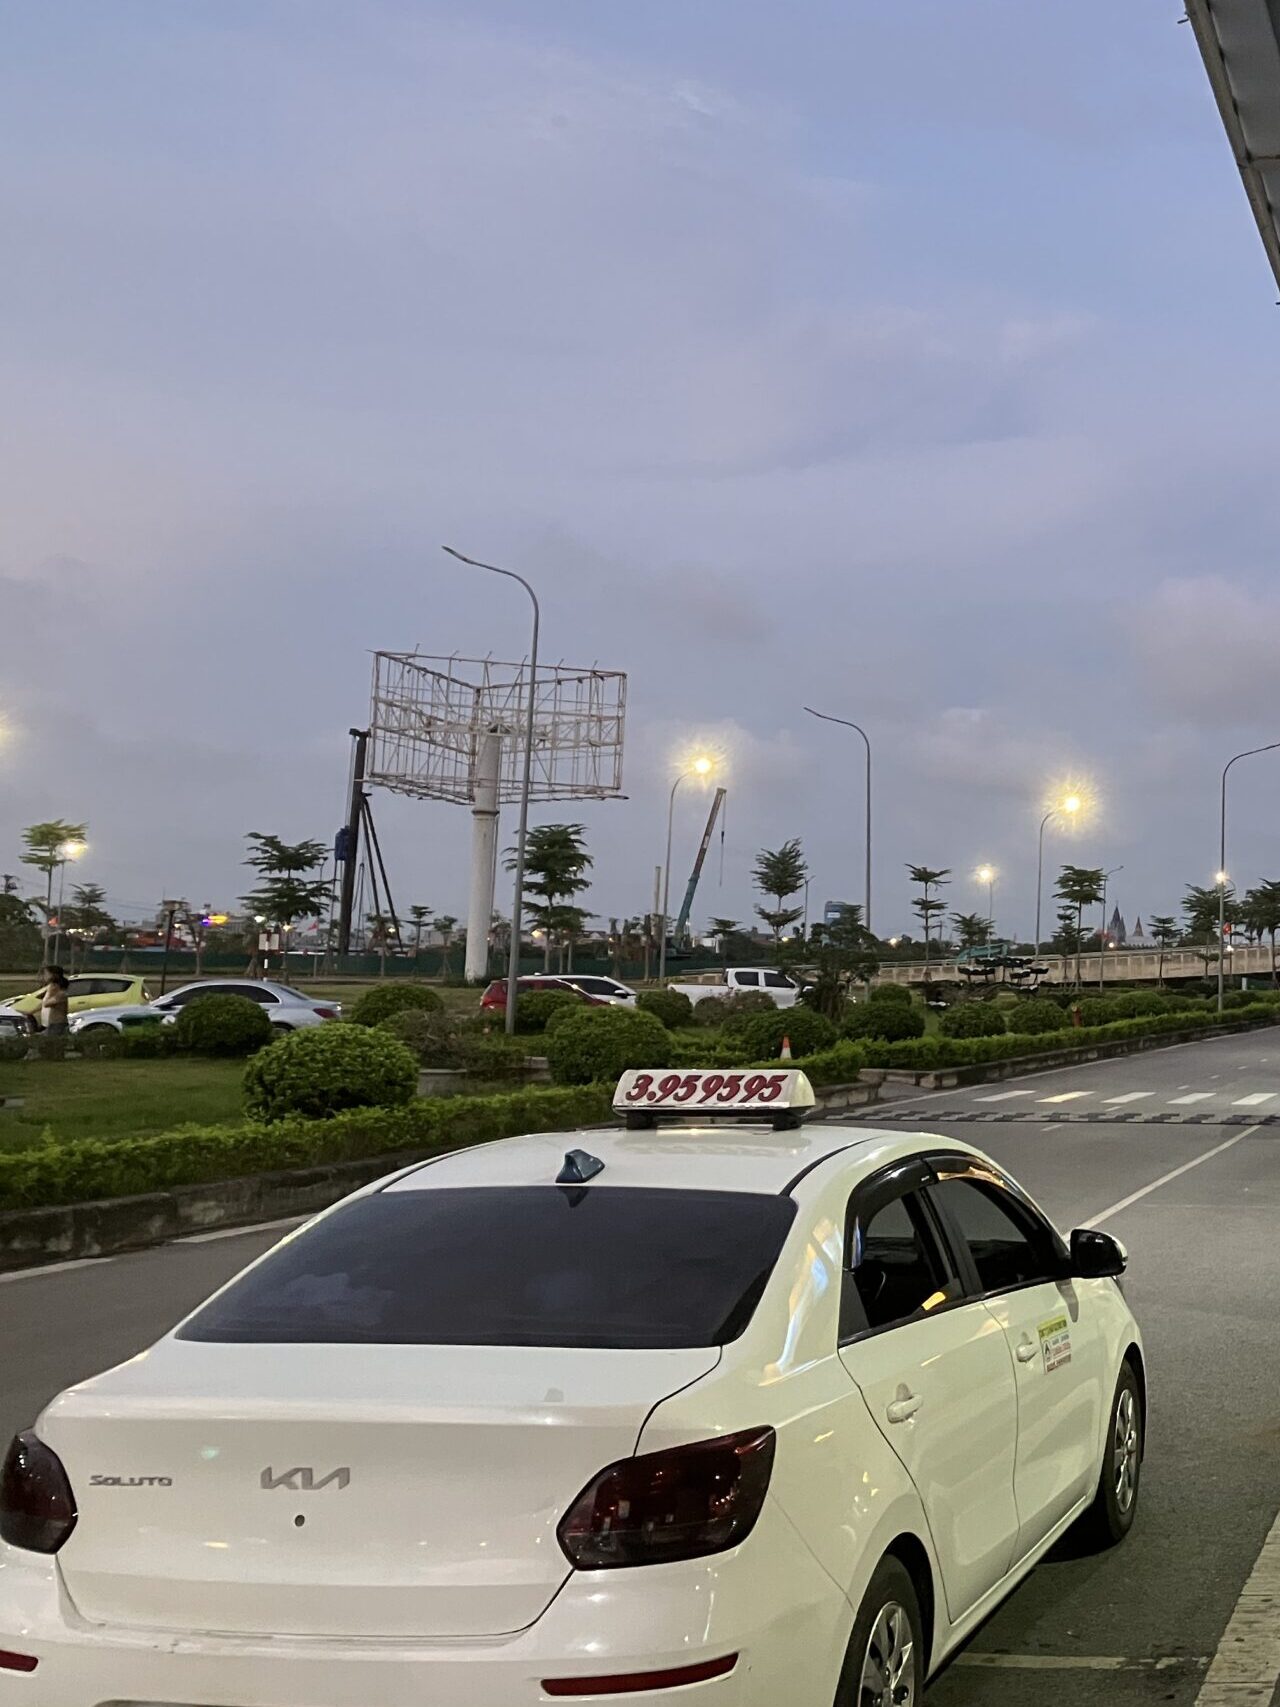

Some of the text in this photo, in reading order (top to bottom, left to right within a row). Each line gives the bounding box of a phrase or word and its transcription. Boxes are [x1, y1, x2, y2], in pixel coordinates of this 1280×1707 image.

[625, 1074, 789, 1104] 3.959595
[89, 1475, 172, 1487] SOLUTO
[260, 1466, 350, 1490] KIA
